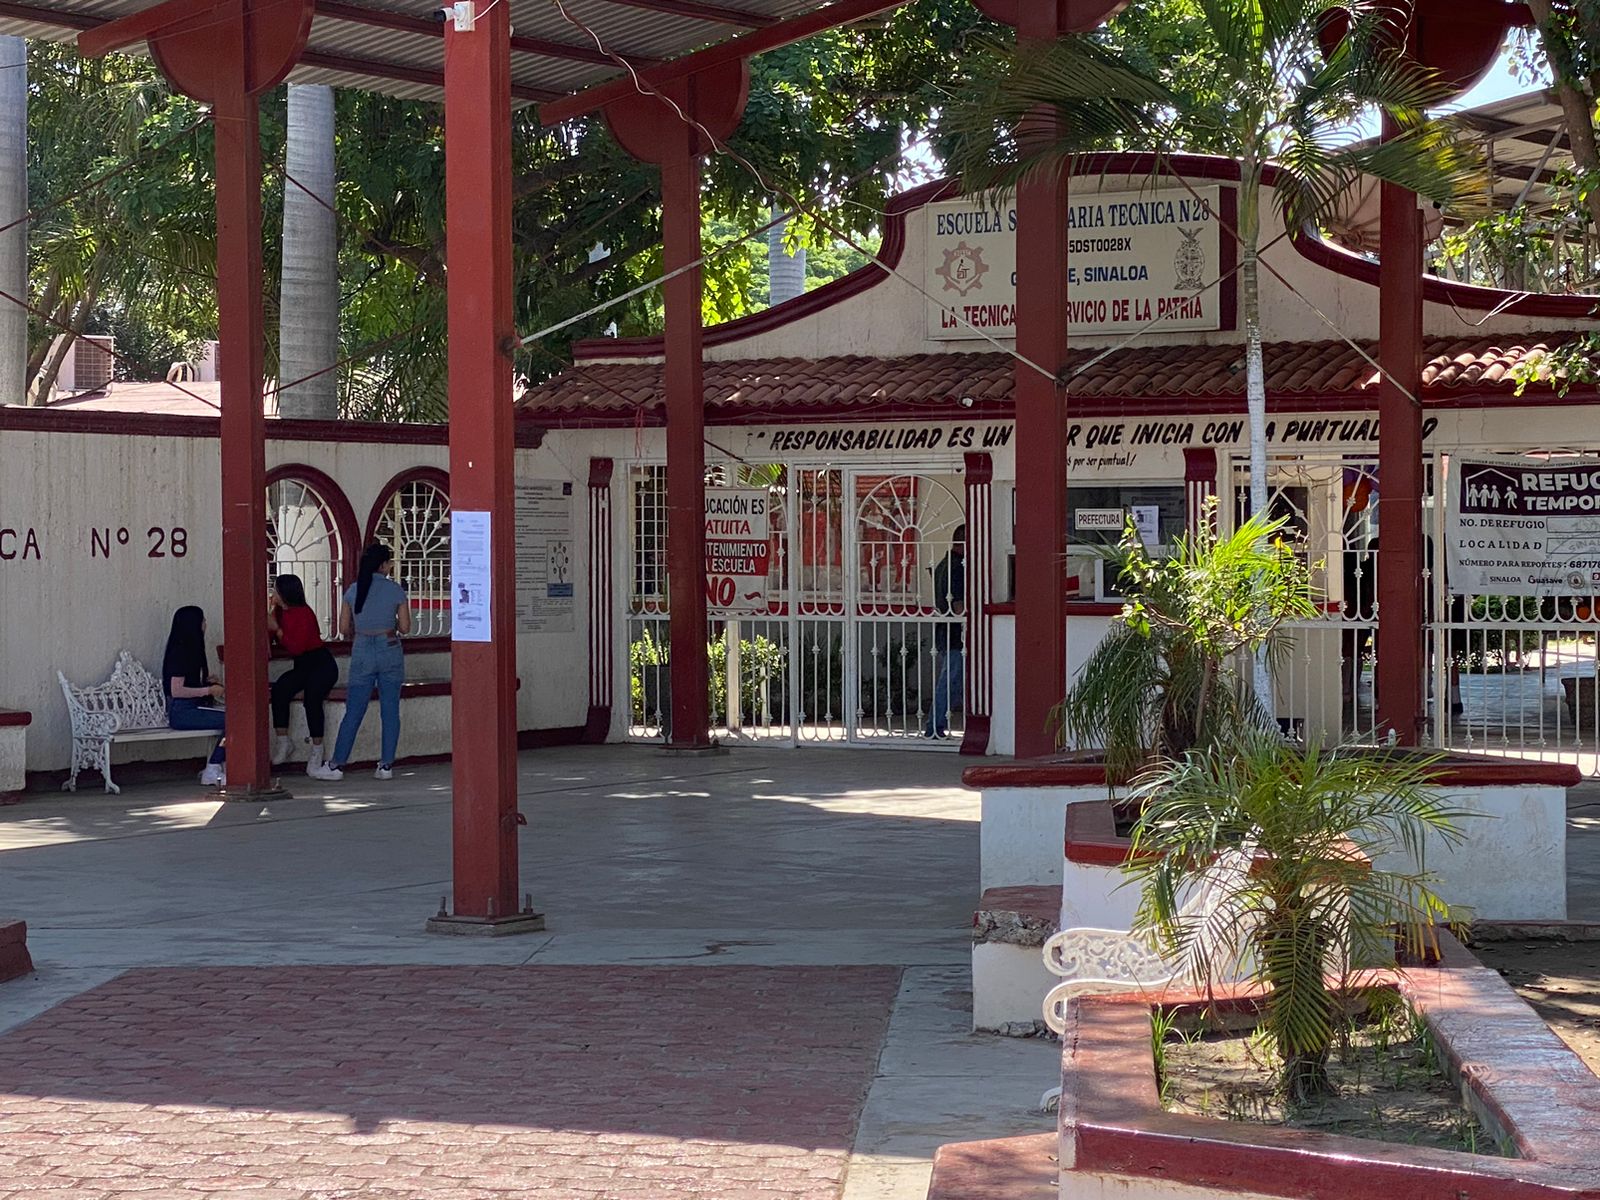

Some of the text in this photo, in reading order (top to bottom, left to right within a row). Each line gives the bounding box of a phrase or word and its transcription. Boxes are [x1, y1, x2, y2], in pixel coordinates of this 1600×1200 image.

[936, 210, 1002, 235] ESCUELA
[1108, 201, 1175, 227] TECNICA
[1068, 237, 1132, 254] 5DST0028X
[1084, 265, 1148, 283] SINALOA
[942, 303, 1016, 328] LA TECNICA
[1067, 296, 1203, 325] RVICIO DE LA PATRIA
[770, 425, 1014, 451] RESPONSABILIDAD ES UN
[1085, 424, 1125, 449] QUE
[1130, 422, 1194, 445] INICIA
[1202, 420, 1244, 444] CON
[1281, 417, 1438, 443] PUNTUALD
[751, 499, 764, 515] ES
[705, 519, 751, 535] ATUITA
[1078, 513, 1121, 526] PREFECTURA
[1459, 518, 1478, 528] NO.
[147, 526, 188, 558] 28
[705, 542, 767, 558] TENIMIENTO
[1459, 539, 1542, 551] LOCALIDAD
[711, 557, 756, 573] ESCUELA
[1459, 558, 1495, 567] NÚMERO
[1496, 560, 1520, 569] PARA
[1489, 575, 1522, 584] SINALOA
